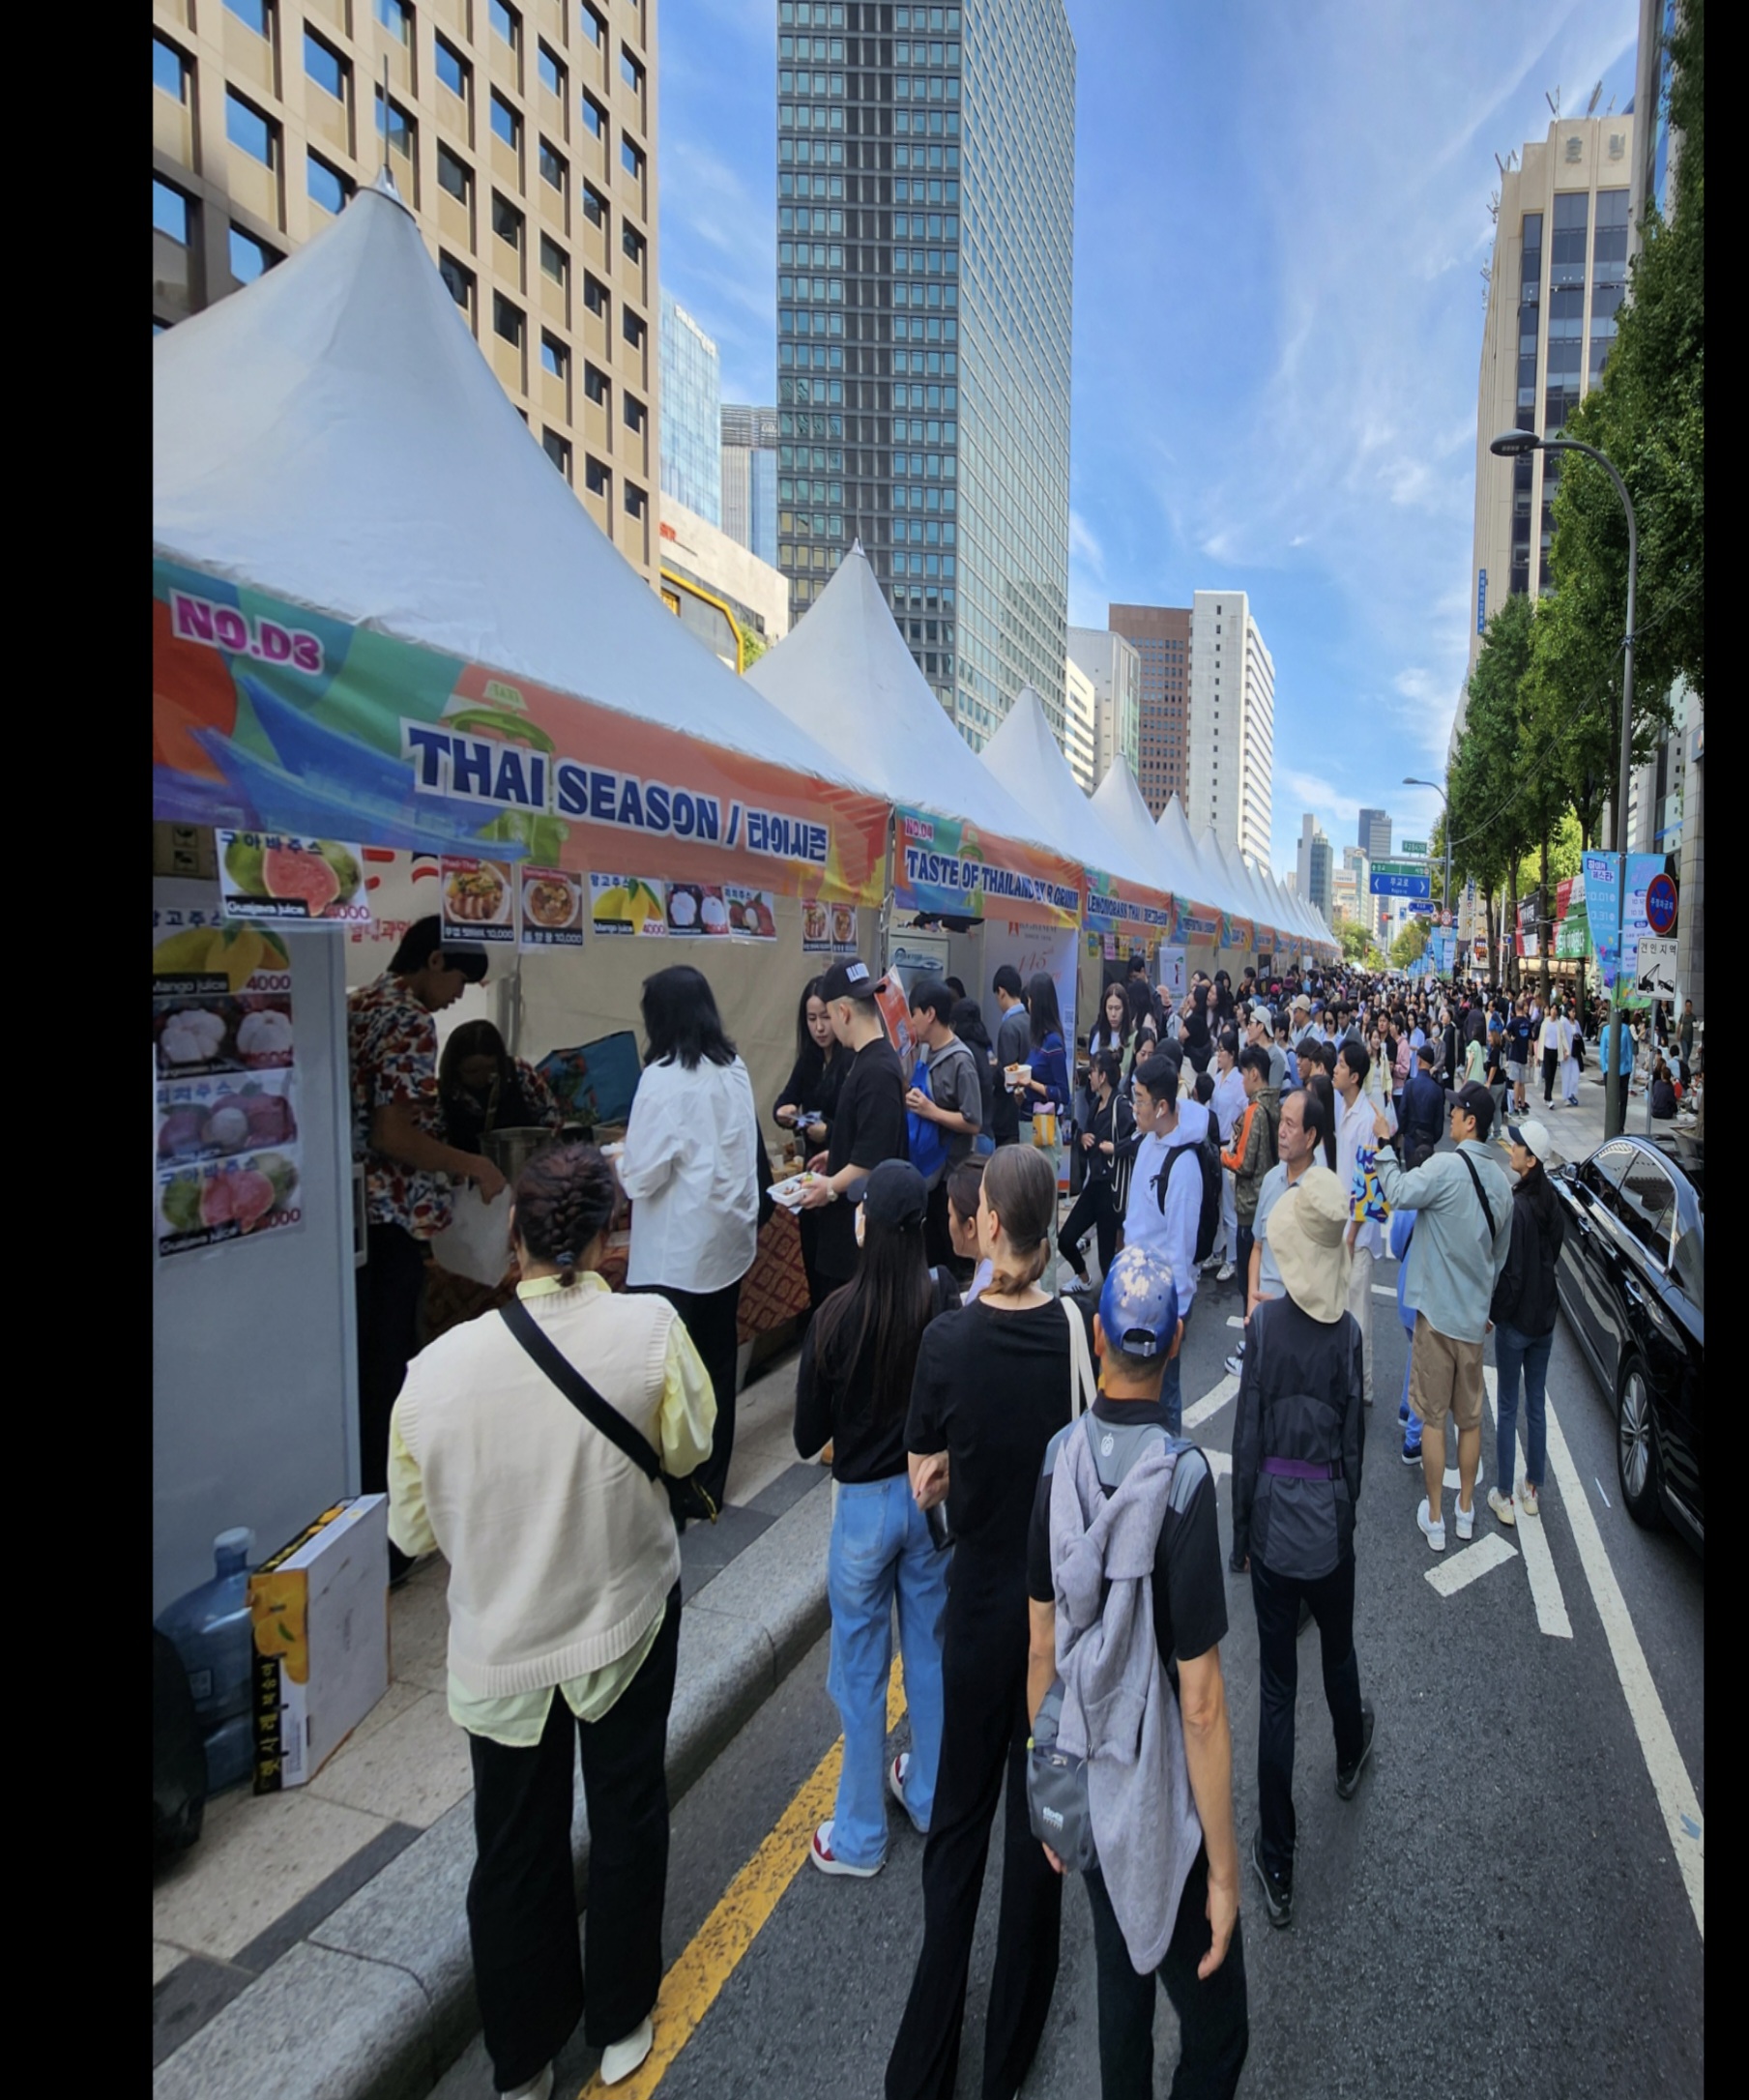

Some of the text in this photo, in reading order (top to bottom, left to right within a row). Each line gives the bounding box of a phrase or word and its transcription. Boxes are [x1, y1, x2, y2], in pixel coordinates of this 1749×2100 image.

[172, 591, 323, 674] NO.D3
[407, 725, 544, 808] THAI
[557, 763, 719, 842] SEASON
[746, 810, 828, 863] 타이시즌
[907, 849, 959, 887] TASTE
[962, 861, 979, 889] OF
[982, 868, 1035, 900] THAILAND
[1589, 911, 1609, 920] 0.31
[1641, 942, 1676, 955] 견인지역
[246, 976, 291, 990] 4000
